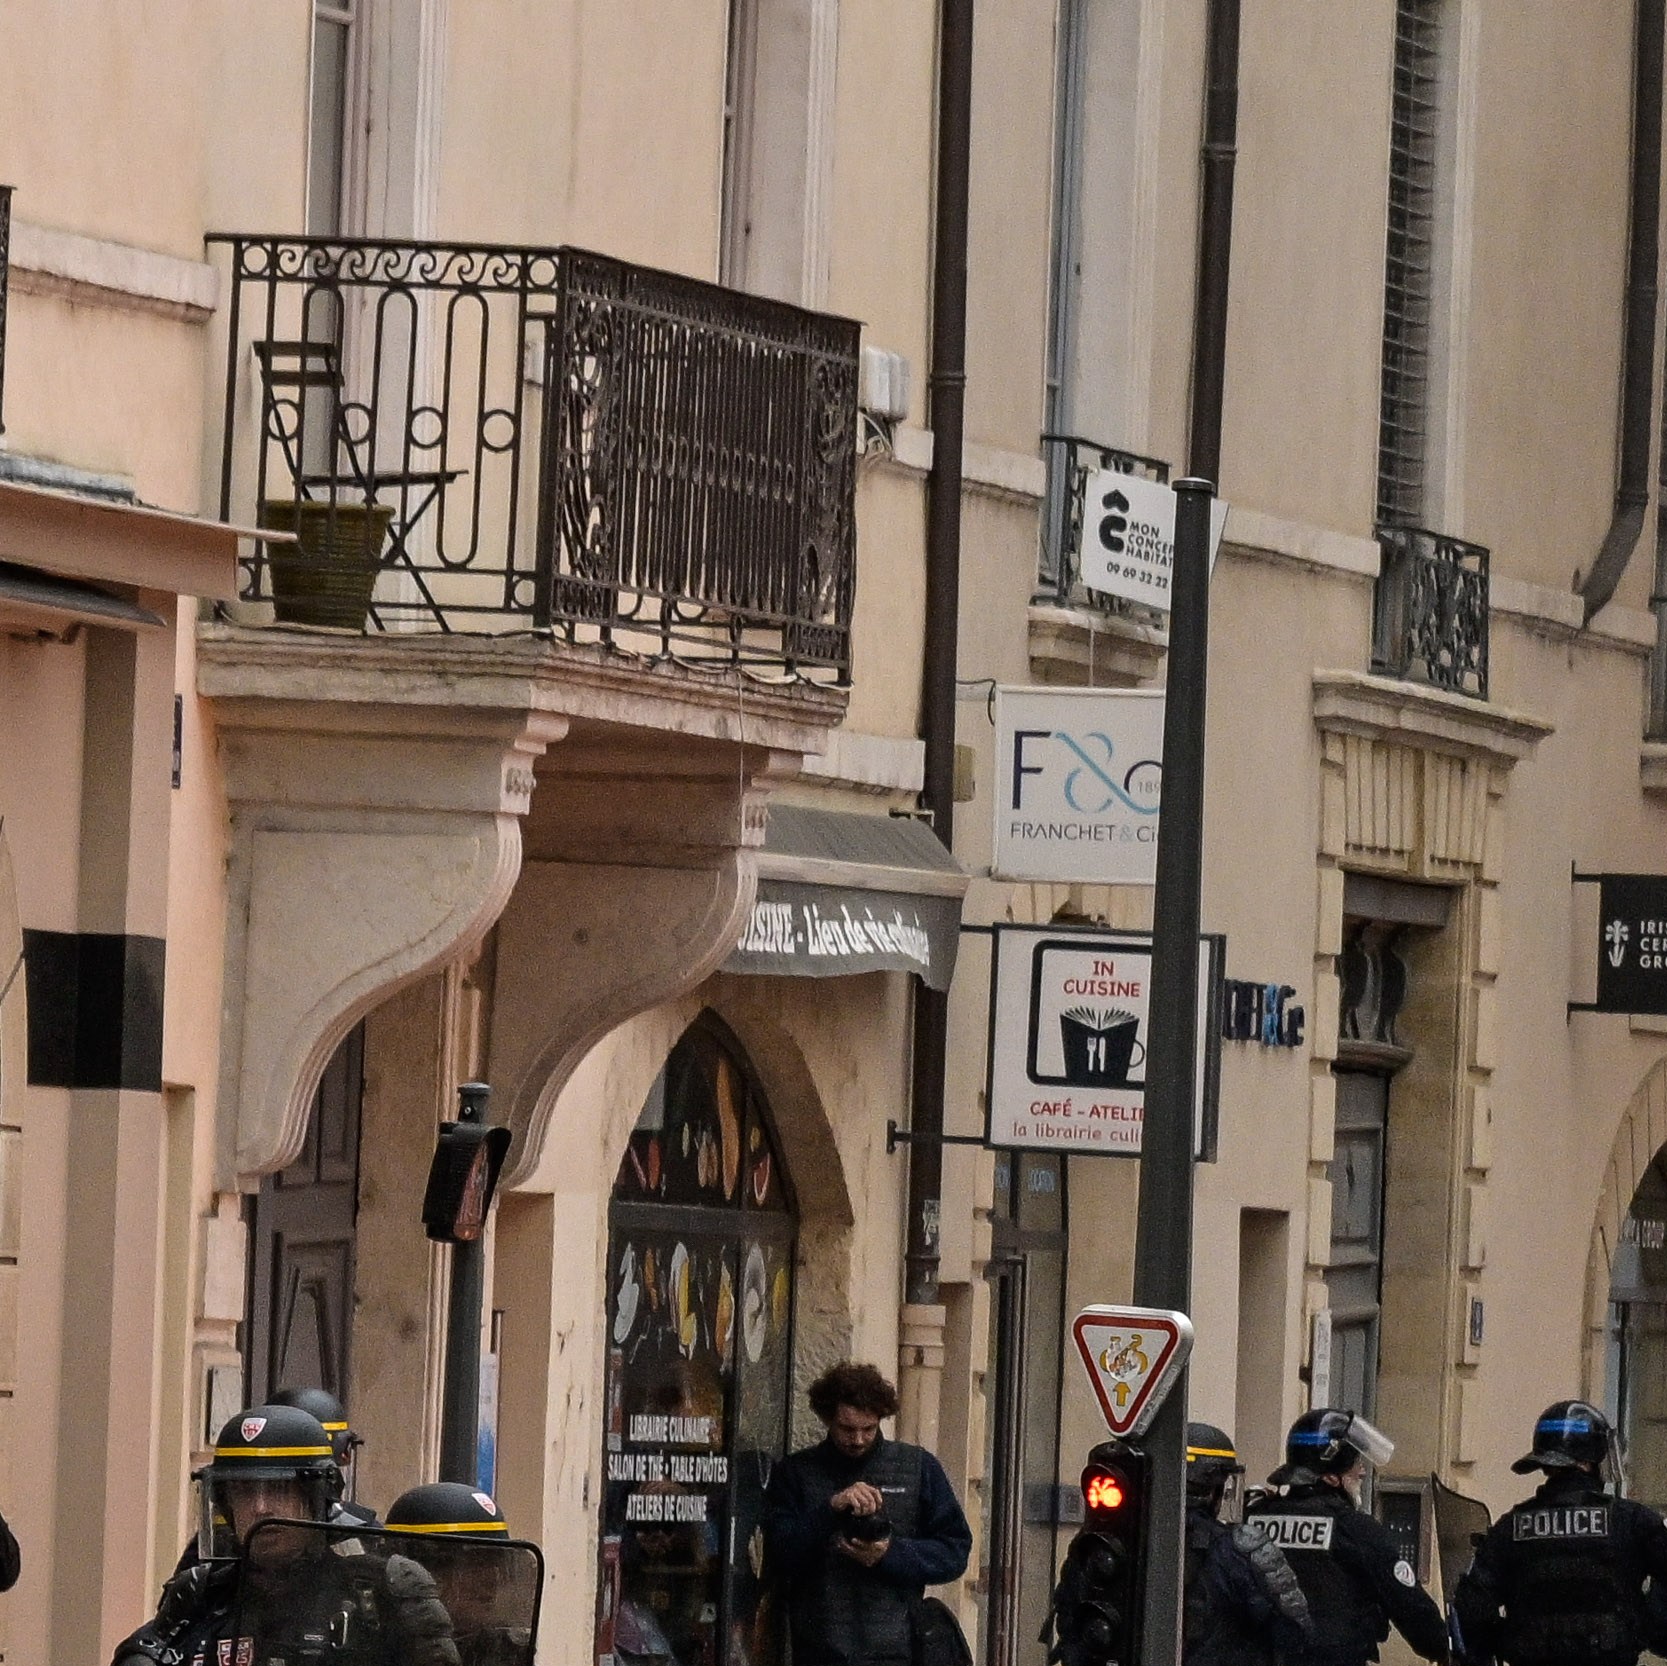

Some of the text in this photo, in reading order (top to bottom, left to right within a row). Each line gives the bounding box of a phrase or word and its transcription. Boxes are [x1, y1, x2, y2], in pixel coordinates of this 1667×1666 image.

[1129, 521, 1160, 539] MON
[1106, 561, 1121, 575] 09
[1010, 822, 1116, 842] FRANCHET
[1136, 825, 1158, 843] Ci
[1092, 960, 1115, 977] IN
[1063, 979, 1141, 998] CUISINE
[1030, 1098, 1073, 1118] CAFÉ
[1013, 1122, 1142, 1143] la librairie culi
[607, 1454, 635, 1481] SALON
[635, 1454, 647, 1482] DE
[670, 1454, 695, 1483] TABLE
[625, 1494, 708, 1522] ATELIERS DE CUISINE
[1518, 1509, 1604, 1539] POLICE
